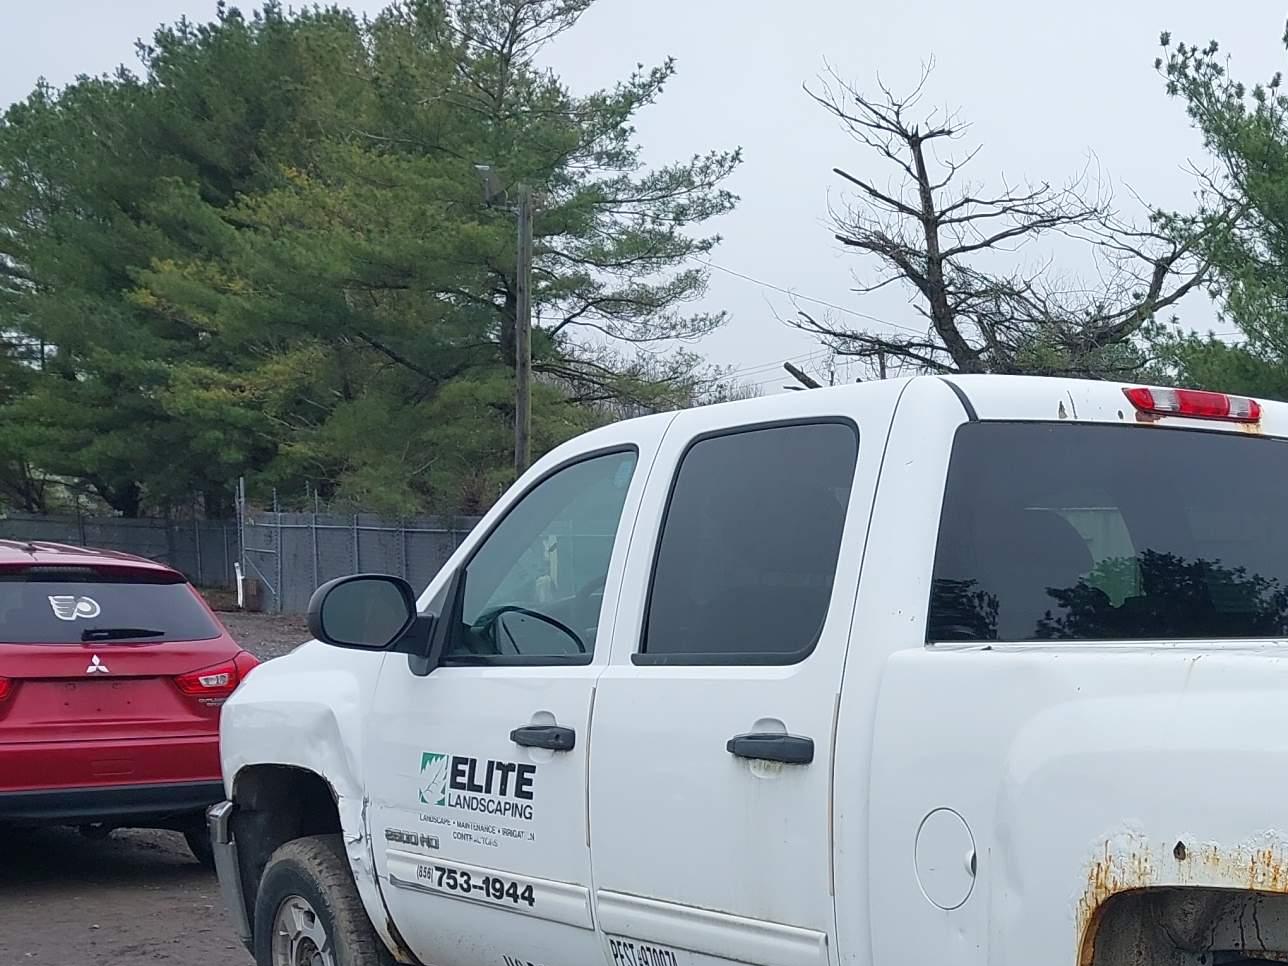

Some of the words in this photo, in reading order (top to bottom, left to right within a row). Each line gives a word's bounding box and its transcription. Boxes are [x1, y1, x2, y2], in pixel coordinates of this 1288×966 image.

[449, 755, 537, 801] ELITE
[447, 792, 533, 820] LANDSCAPING
[416, 864, 434, 883] (856)
[434, 866, 535, 907] 753-1944
